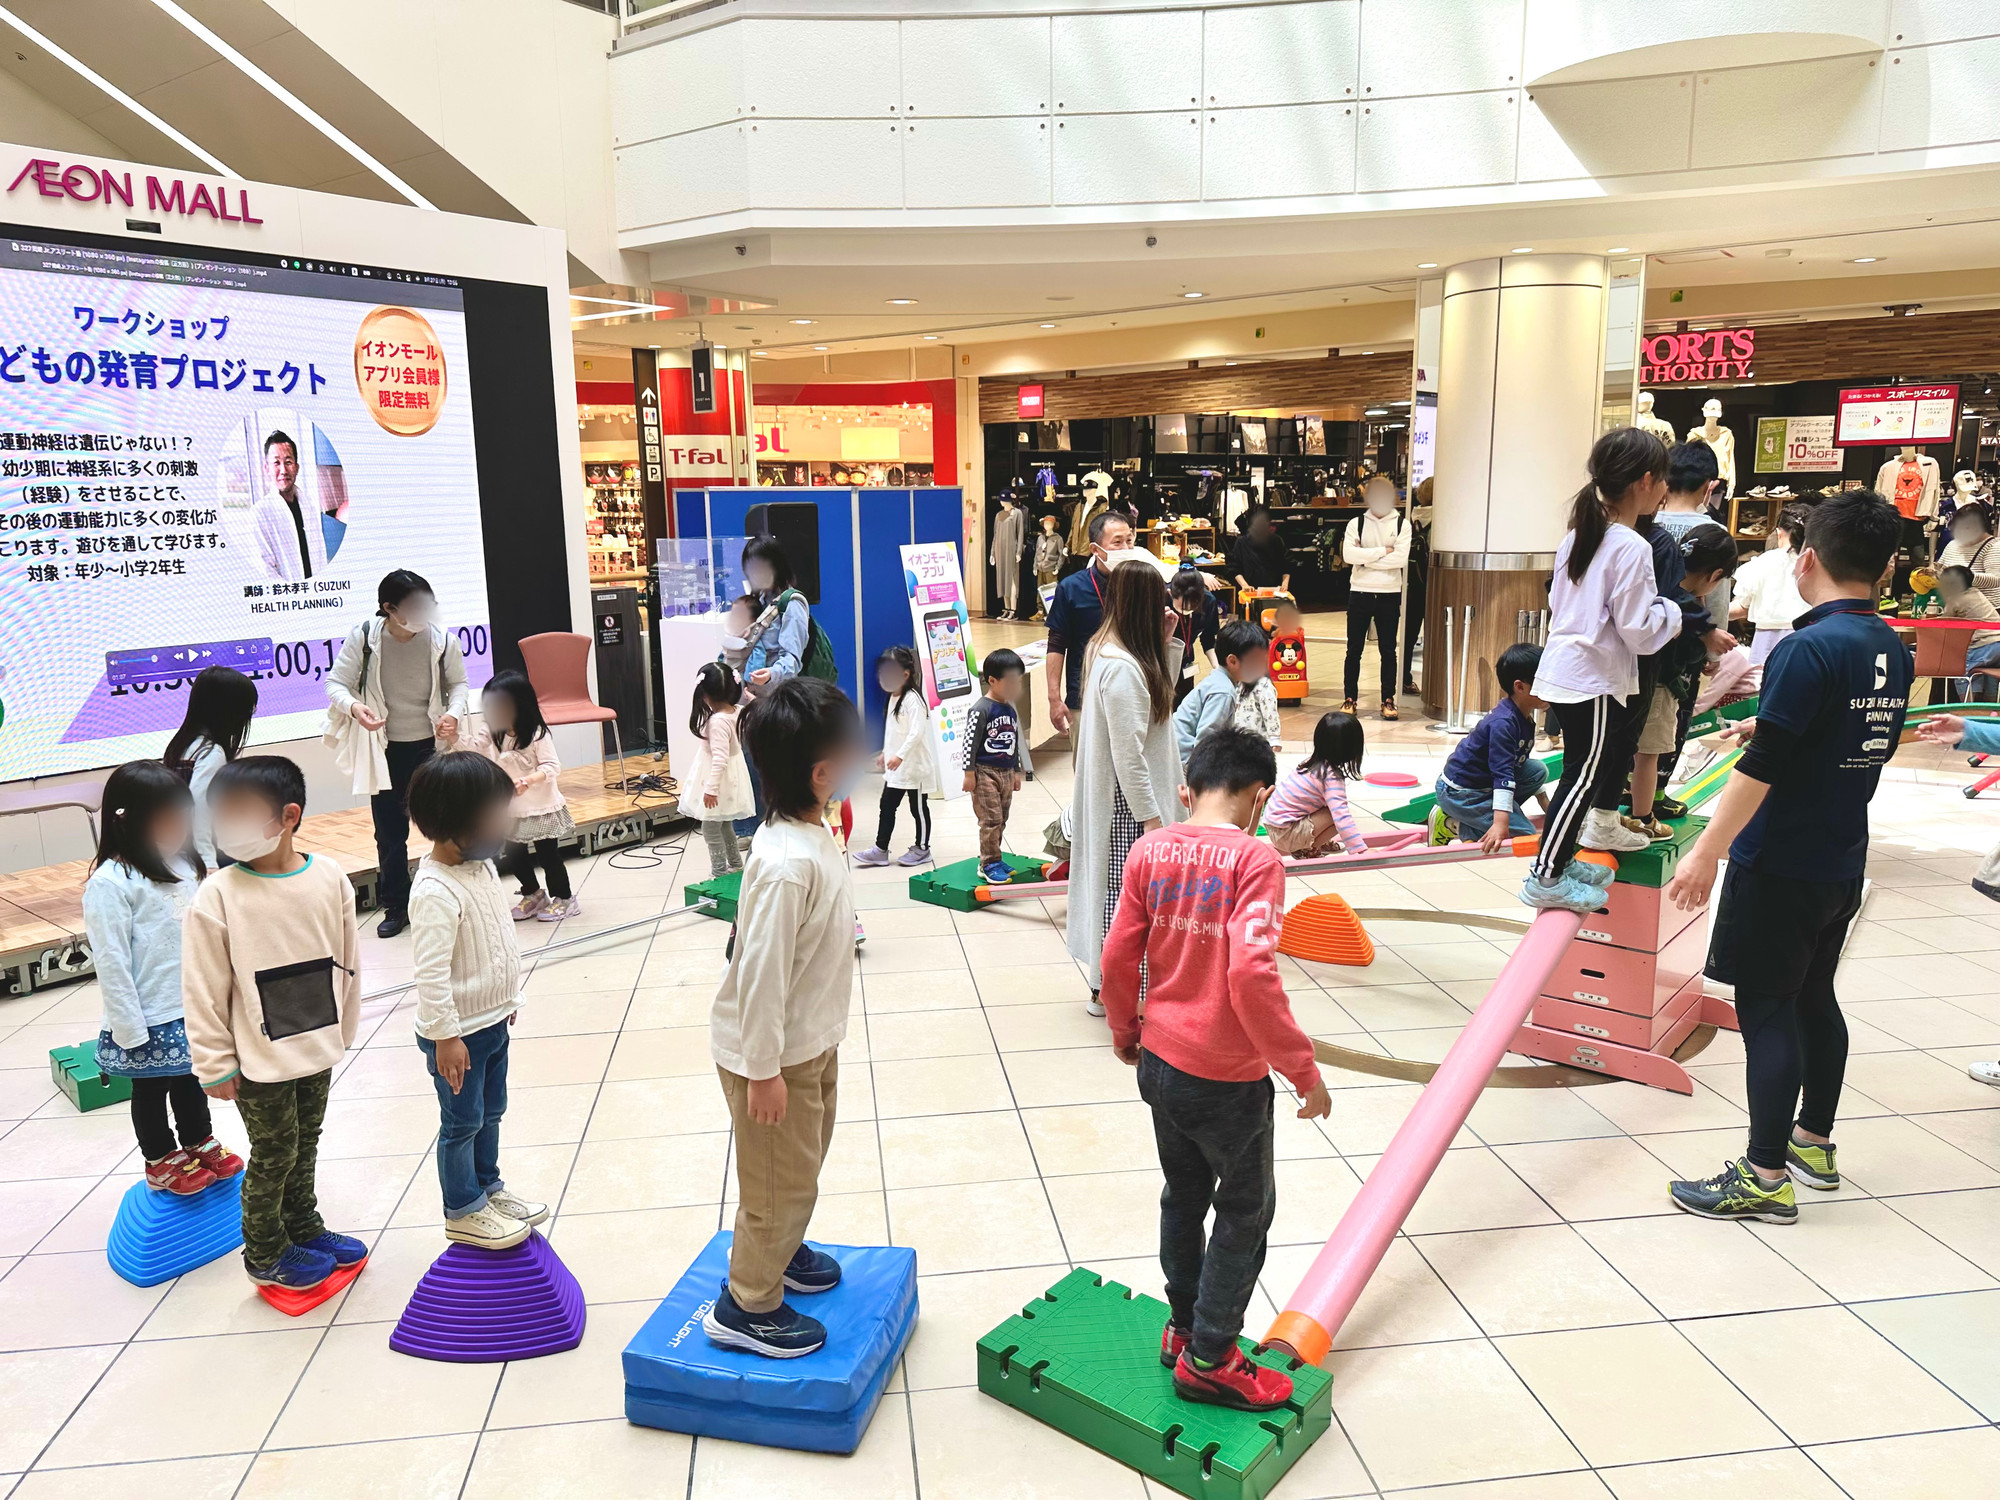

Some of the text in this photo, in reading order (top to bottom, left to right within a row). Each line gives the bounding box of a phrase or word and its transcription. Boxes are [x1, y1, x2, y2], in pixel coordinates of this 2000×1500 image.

[147, 176, 264, 225] MALL
[73, 306, 230, 341] ワークショップ
[361, 340, 438, 361] イオンモール
[0, 344, 327, 395] どもの発育プロジェクト
[363, 365, 440, 386] アプリ会員様
[698, 372, 706, 392] 1
[379, 390, 430, 409] 限定無料
[1886, 389, 1950, 400] スポーツマイル
[669, 448, 728, 465] T-fal
[1788, 443, 1839, 459] 10%OFF
[2, 459, 199, 477] 幼少期に神経系に多くの刺激
[22, 485, 186, 504] （経験）をさせることで、
[0, 508, 218, 530] その後の運動能力に多くの変化が
[0, 532, 227, 557] こります。遊びを通して学びます。
[908, 551, 954, 566] イオンモール
[922, 565, 945, 578] アプリ
[250, 600, 289, 614] HEALTH
[1143, 842, 1240, 870] RECREATION
[691, 1299, 716, 1322] TOEI
[668, 1320, 697, 1348] LIGHT
